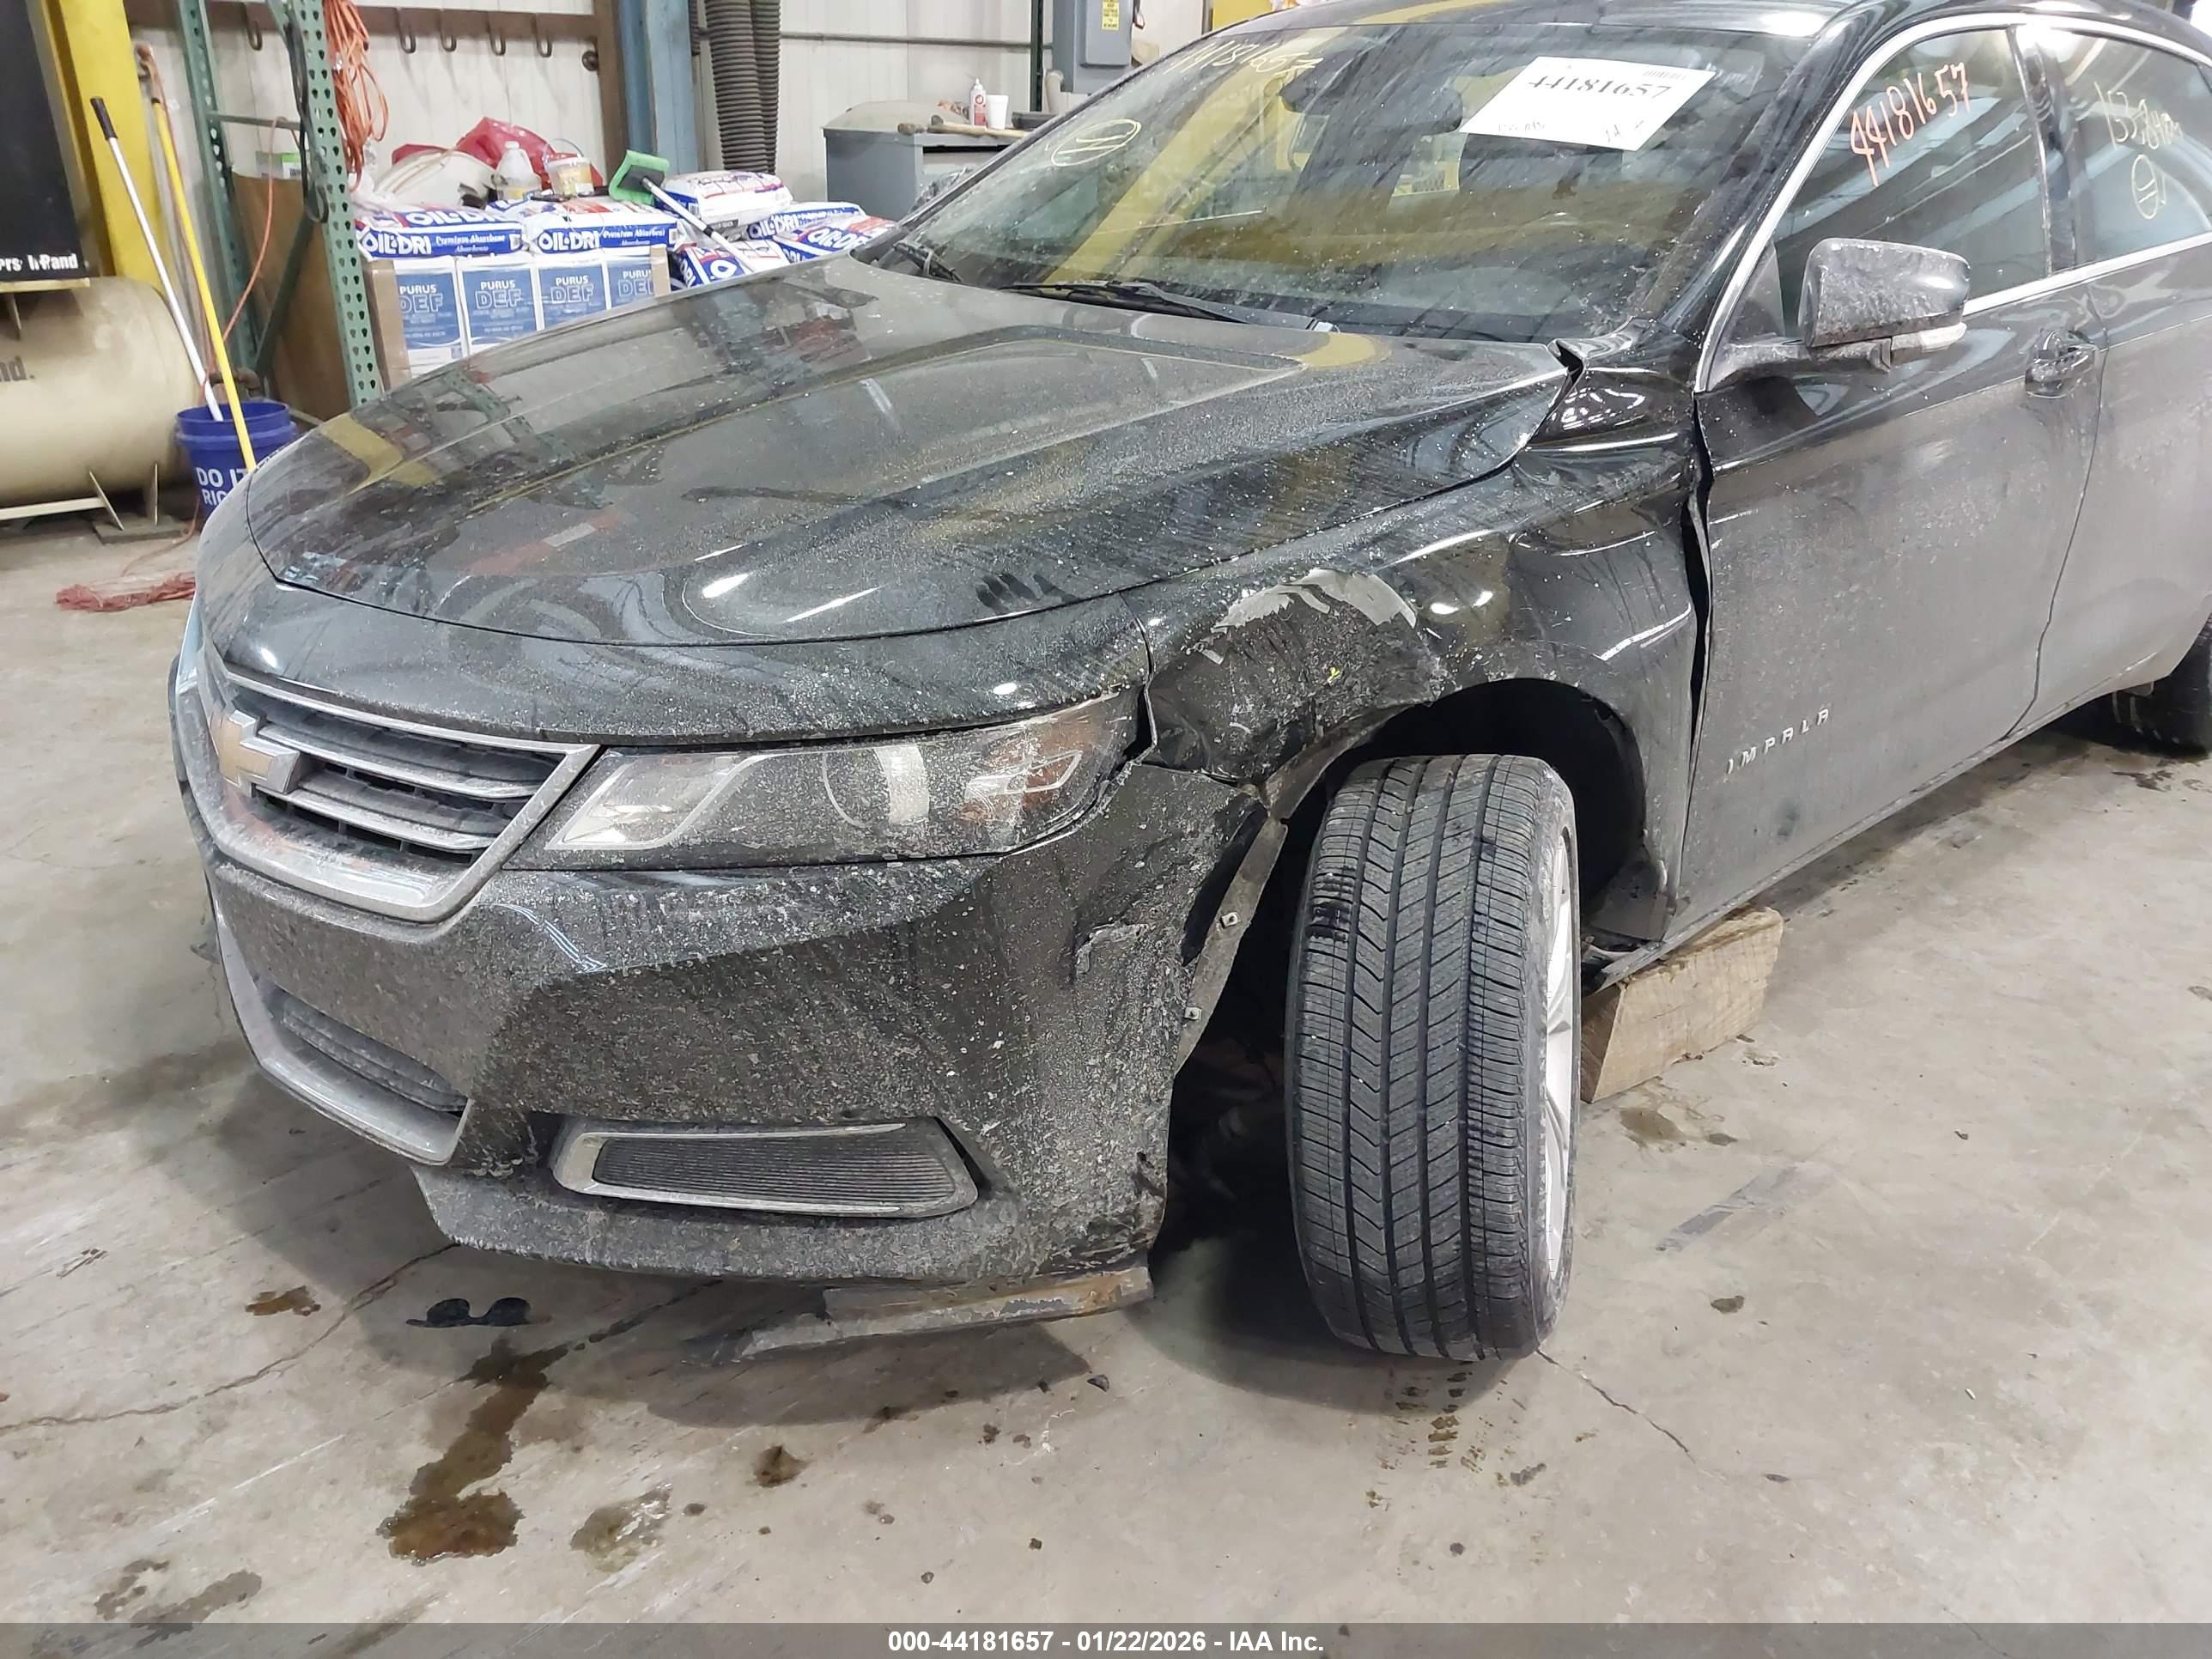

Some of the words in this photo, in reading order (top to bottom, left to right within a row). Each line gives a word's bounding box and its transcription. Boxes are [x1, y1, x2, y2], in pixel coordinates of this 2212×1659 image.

[1528, 76, 1673, 99] 44181657
[1850, 62, 1971, 186] 44181657
[399, 283, 437, 295] PURUS
[481, 279, 516, 291] PURUS
[556, 275, 589, 286] PURUS
[398, 293, 443, 314] DEF
[475, 289, 522, 310] DEF
[550, 283, 594, 304] DEF
[196, 467, 224, 488] DO
[1727, 708, 1829, 775] IMPALA
